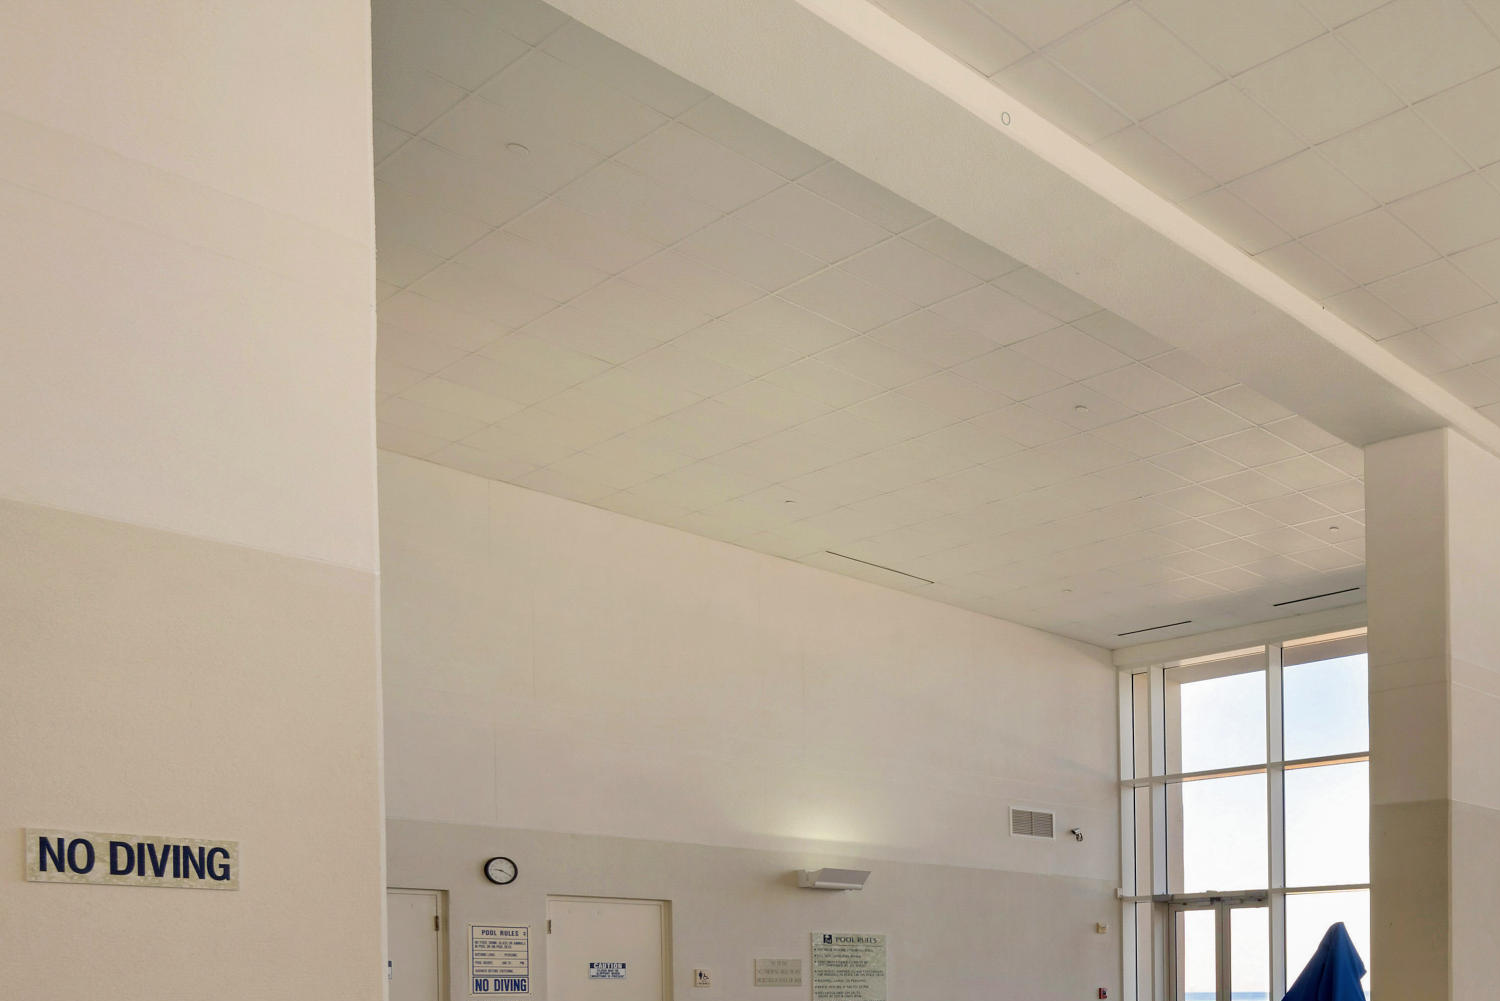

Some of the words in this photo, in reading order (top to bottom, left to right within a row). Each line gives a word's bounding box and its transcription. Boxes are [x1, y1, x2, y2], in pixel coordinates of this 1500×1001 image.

[38, 836, 96, 875] NO
[108, 840, 231, 882] DIVING
[475, 978, 489, 992] NO
[494, 978, 527, 992] DIVING
